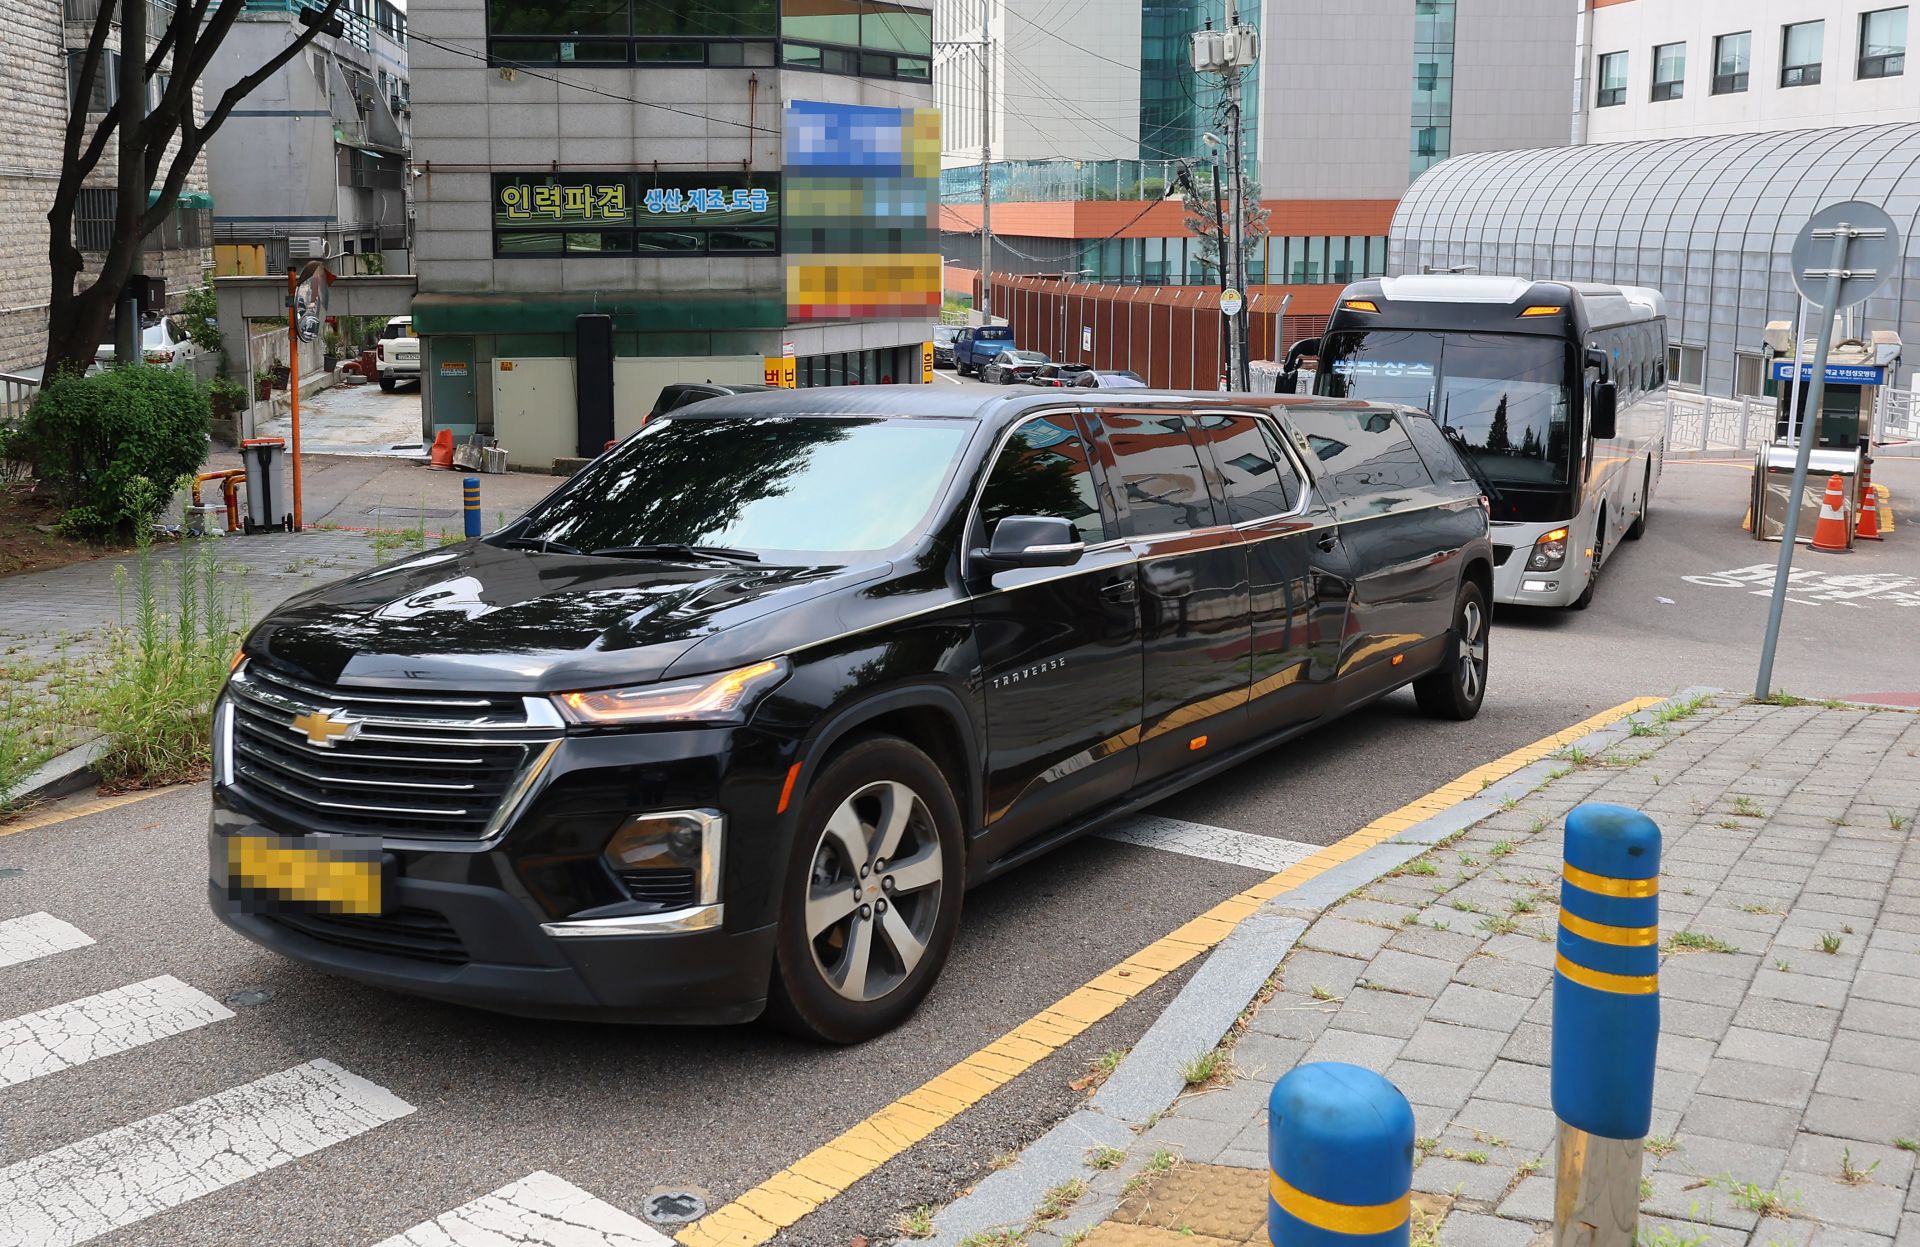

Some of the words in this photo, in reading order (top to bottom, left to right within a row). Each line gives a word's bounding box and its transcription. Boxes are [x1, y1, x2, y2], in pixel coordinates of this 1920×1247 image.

[501, 183, 626, 219] 인력파견
[644, 187, 769, 213] 생산.제조.도급
[1839, 370, 1876, 378] 부천성모병원
[993, 657, 1065, 689] TRAVERSE
